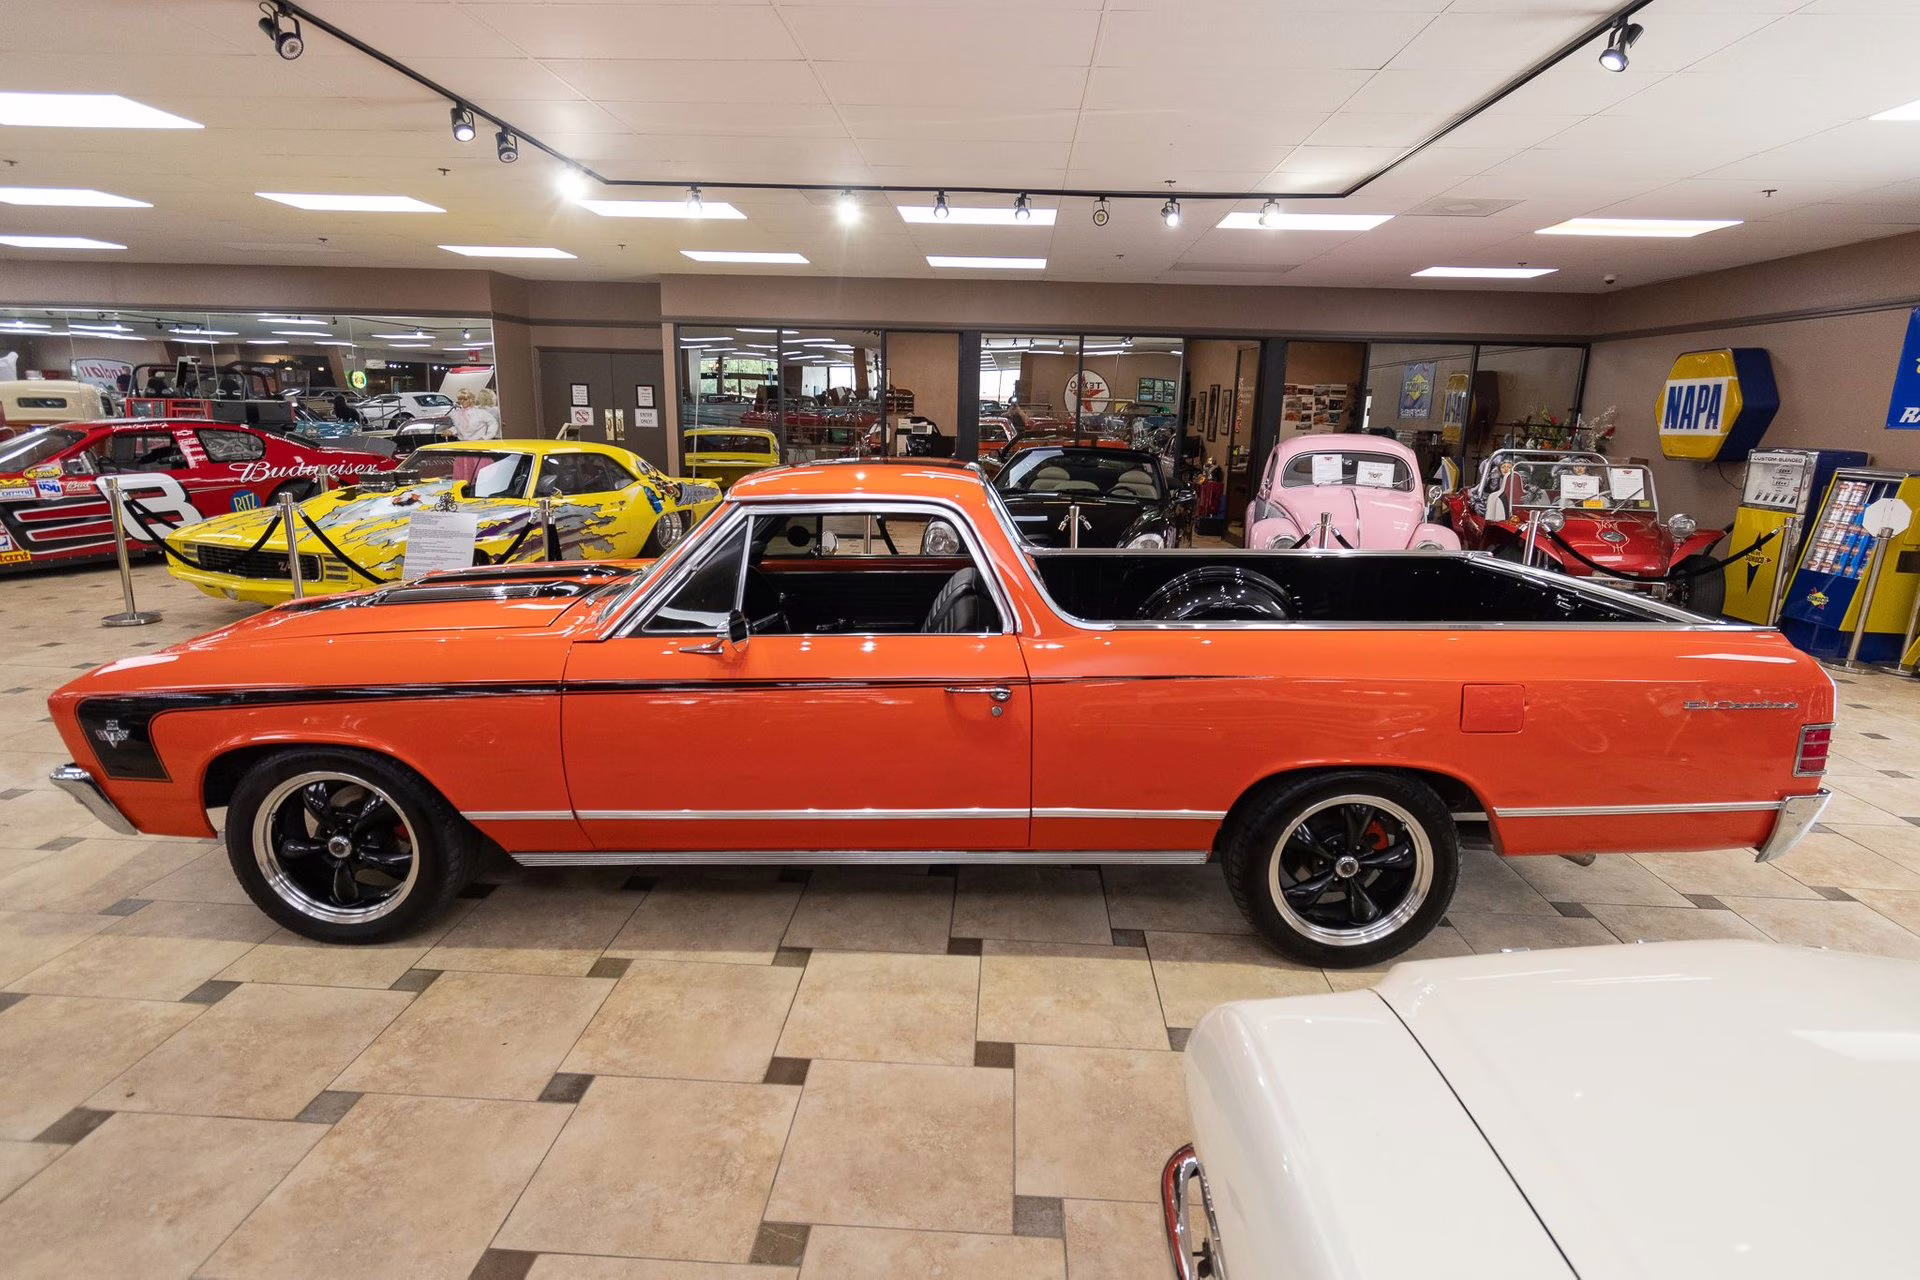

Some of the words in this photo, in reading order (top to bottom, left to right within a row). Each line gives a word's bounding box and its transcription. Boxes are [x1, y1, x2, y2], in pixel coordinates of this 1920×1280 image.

[1664, 384, 1722, 429] NAPA
[229, 457, 378, 483] Budweiser
[96, 473, 203, 541] 8
[233, 493, 256, 512] RITZ
